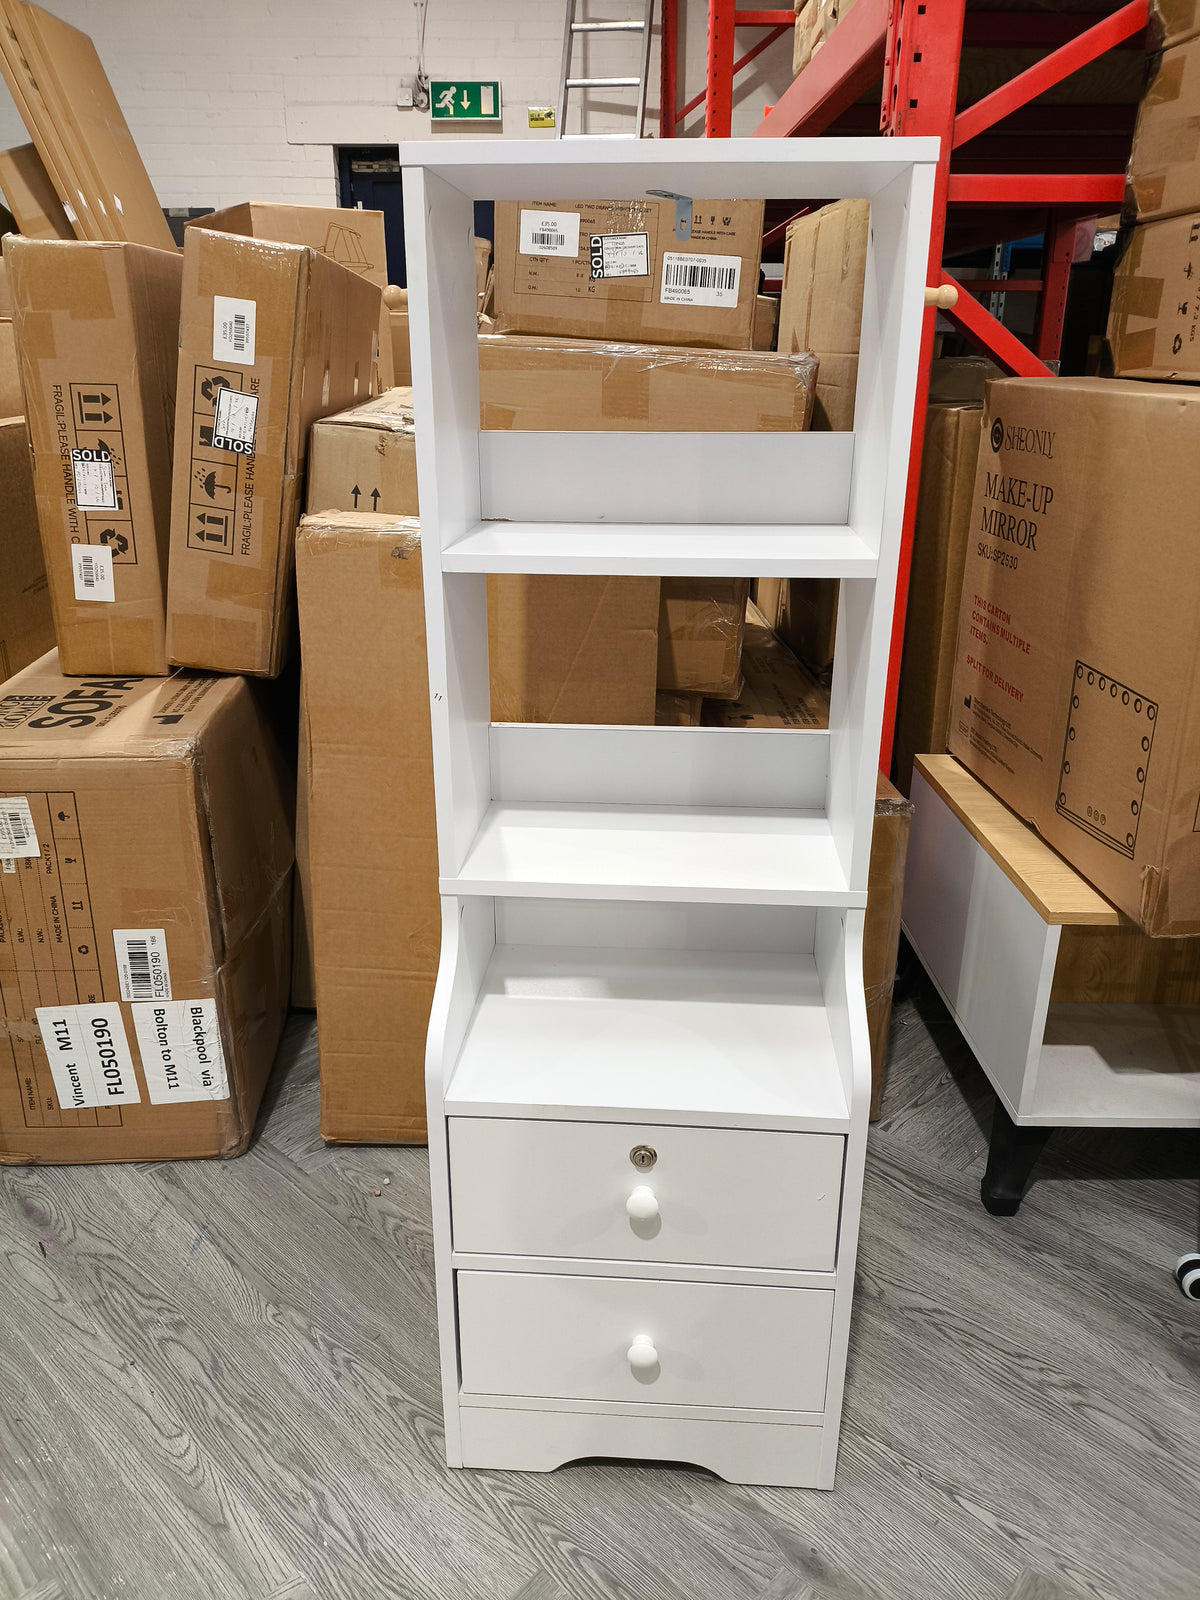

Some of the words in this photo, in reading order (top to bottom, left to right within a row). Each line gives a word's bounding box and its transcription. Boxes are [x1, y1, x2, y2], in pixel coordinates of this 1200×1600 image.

[592, 236, 604, 278] SOLD
[72, 449, 112, 462] SOLD
[214, 436, 253, 455] SOLD
[1004, 426, 1056, 460] SHEONLY
[62, 464, 76, 504] HANDLE
[984, 472, 1054, 515] MAKE-UP
[68, 508, 80, 533] WITH
[980, 506, 1038, 551] MIRROR
[974, 594, 986, 610] THIS
[987, 603, 1011, 625] CARTON
[972, 610, 1000, 635] CONTAINS
[1000, 626, 1031, 655] MULTIPLE
[966, 654, 982, 673] SPLIT
[982, 666, 994, 682] FOR
[994, 675, 1024, 702] DELIVERY
[28, 678, 144, 728] SOFA
[50, 896, 58, 916] CHINA
[54, 924, 63, 943] MADE
[150, 952, 164, 998] FL050190
[52, 1018, 73, 1051] M11
[154, 1008, 168, 1046] Bolton
[190, 1006, 212, 1064] Blackpool
[201, 1070, 214, 1086] via
[91, 1018, 124, 1096] FL050190
[162, 1048, 171, 1061] to
[66, 1062, 85, 1106] Vincent
[164, 1064, 180, 1090] M11
